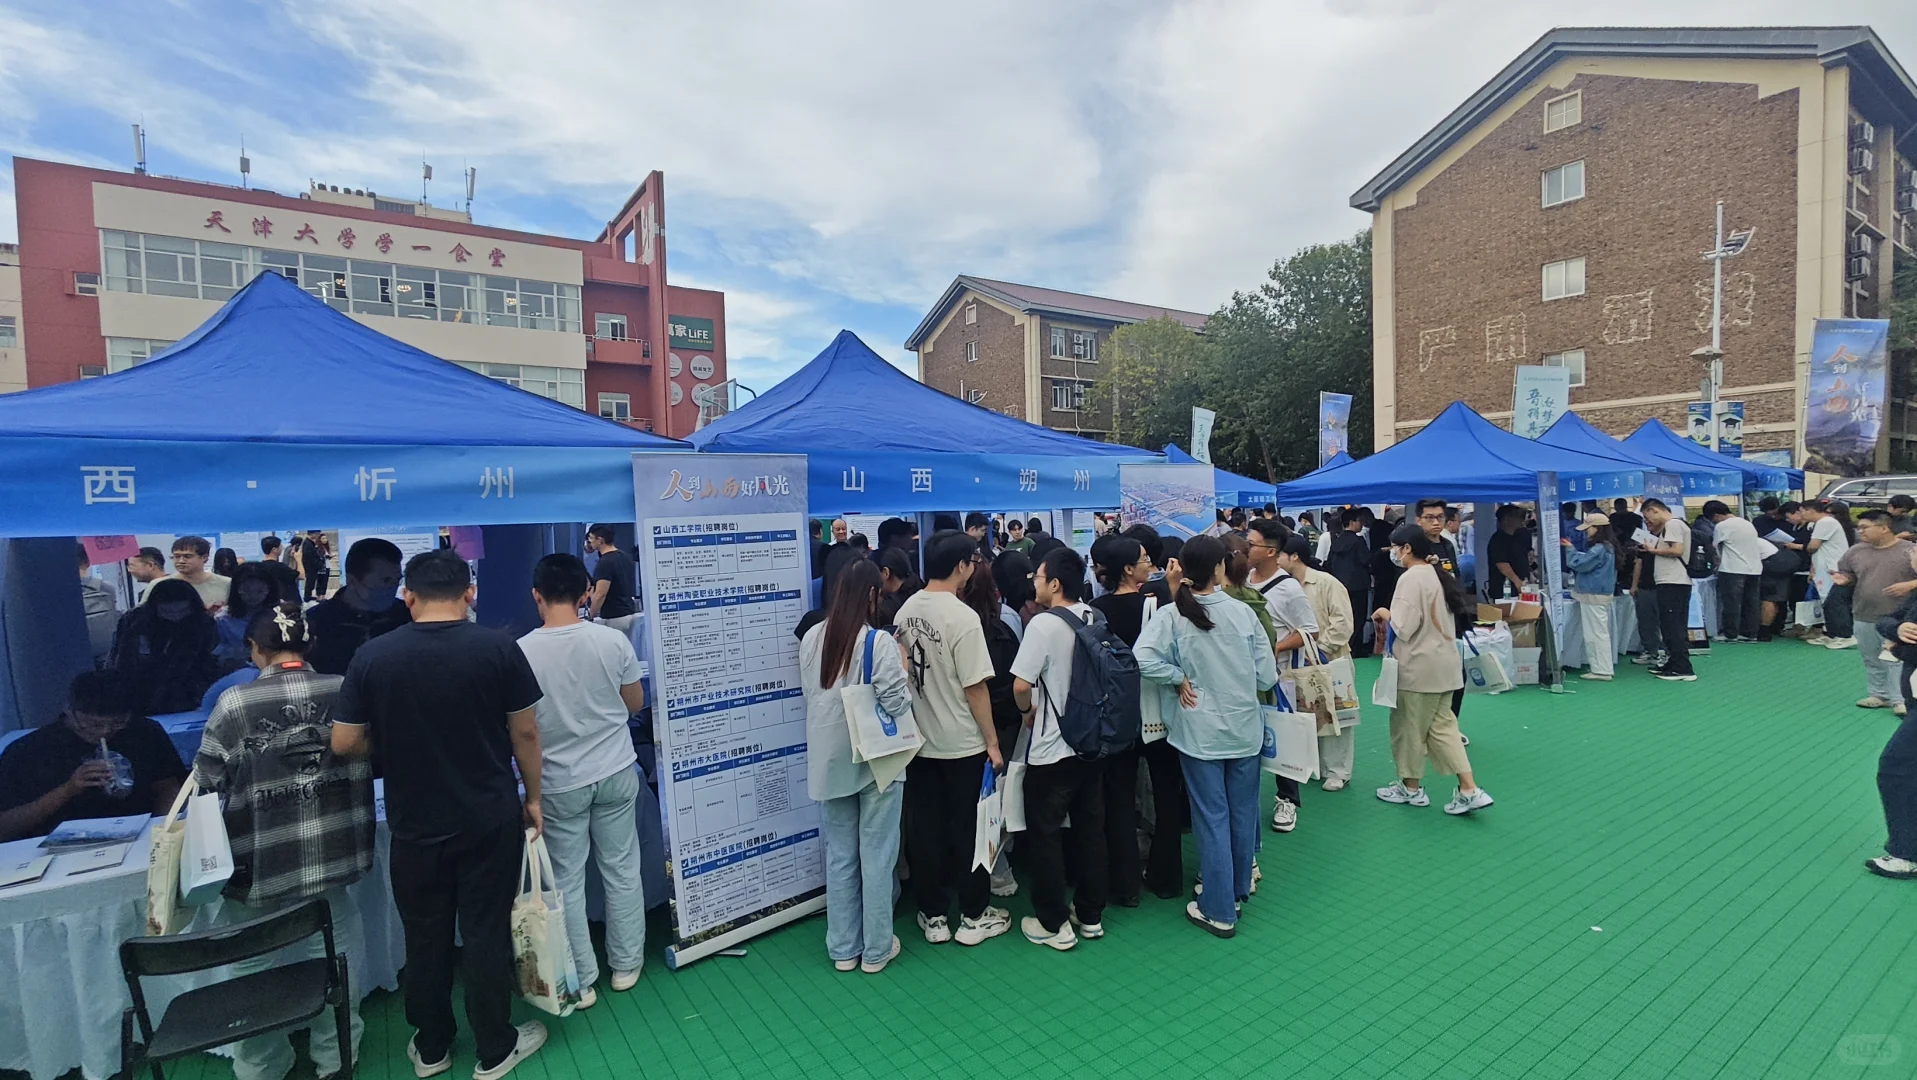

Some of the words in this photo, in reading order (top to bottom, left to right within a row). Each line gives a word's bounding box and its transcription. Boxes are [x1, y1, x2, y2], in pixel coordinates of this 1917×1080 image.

[204, 210, 506, 268] 天津大学学一食堂
[660, 469, 789, 502] 人到山西好风光
[842, 466, 1090, 493] 山西·朔州
